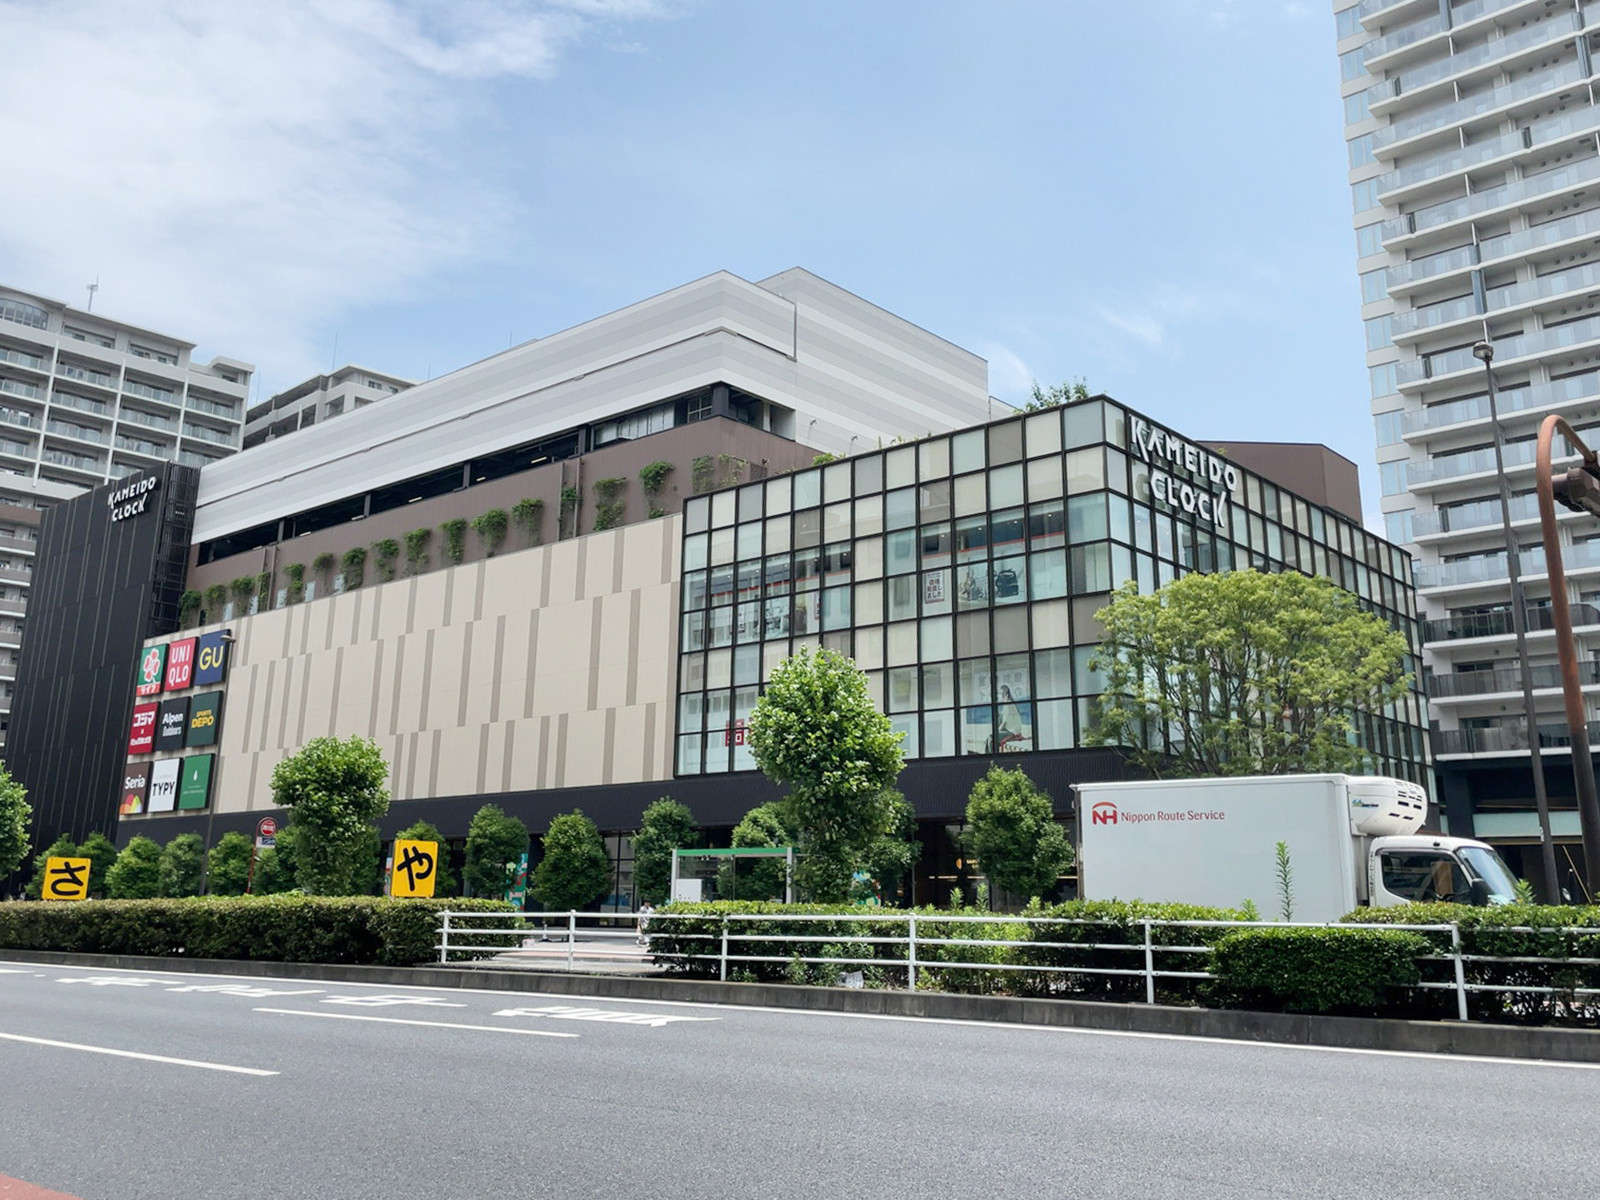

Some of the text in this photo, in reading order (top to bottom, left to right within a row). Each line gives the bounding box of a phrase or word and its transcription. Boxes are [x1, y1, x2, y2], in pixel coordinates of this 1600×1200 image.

[1128, 413, 1238, 492] KAMEIDO
[107, 476, 157, 509] KAMEIDO
[1150, 468, 1226, 528] CLOCK
[111, 492, 148, 522] CLOCK
[172, 645, 191, 664] UNI
[200, 645, 224, 671] GU
[169, 665, 189, 687] QLO
[133, 711, 155, 727] コジマ
[162, 712, 183, 725] Alpen
[191, 715, 214, 728] DEPO
[125, 774, 145, 789] Seria
[153, 781, 175, 796] TYPY
[1121, 809, 1226, 824] Nippon Route Service
[50, 861, 86, 896] さ
[396, 845, 433, 892] や
